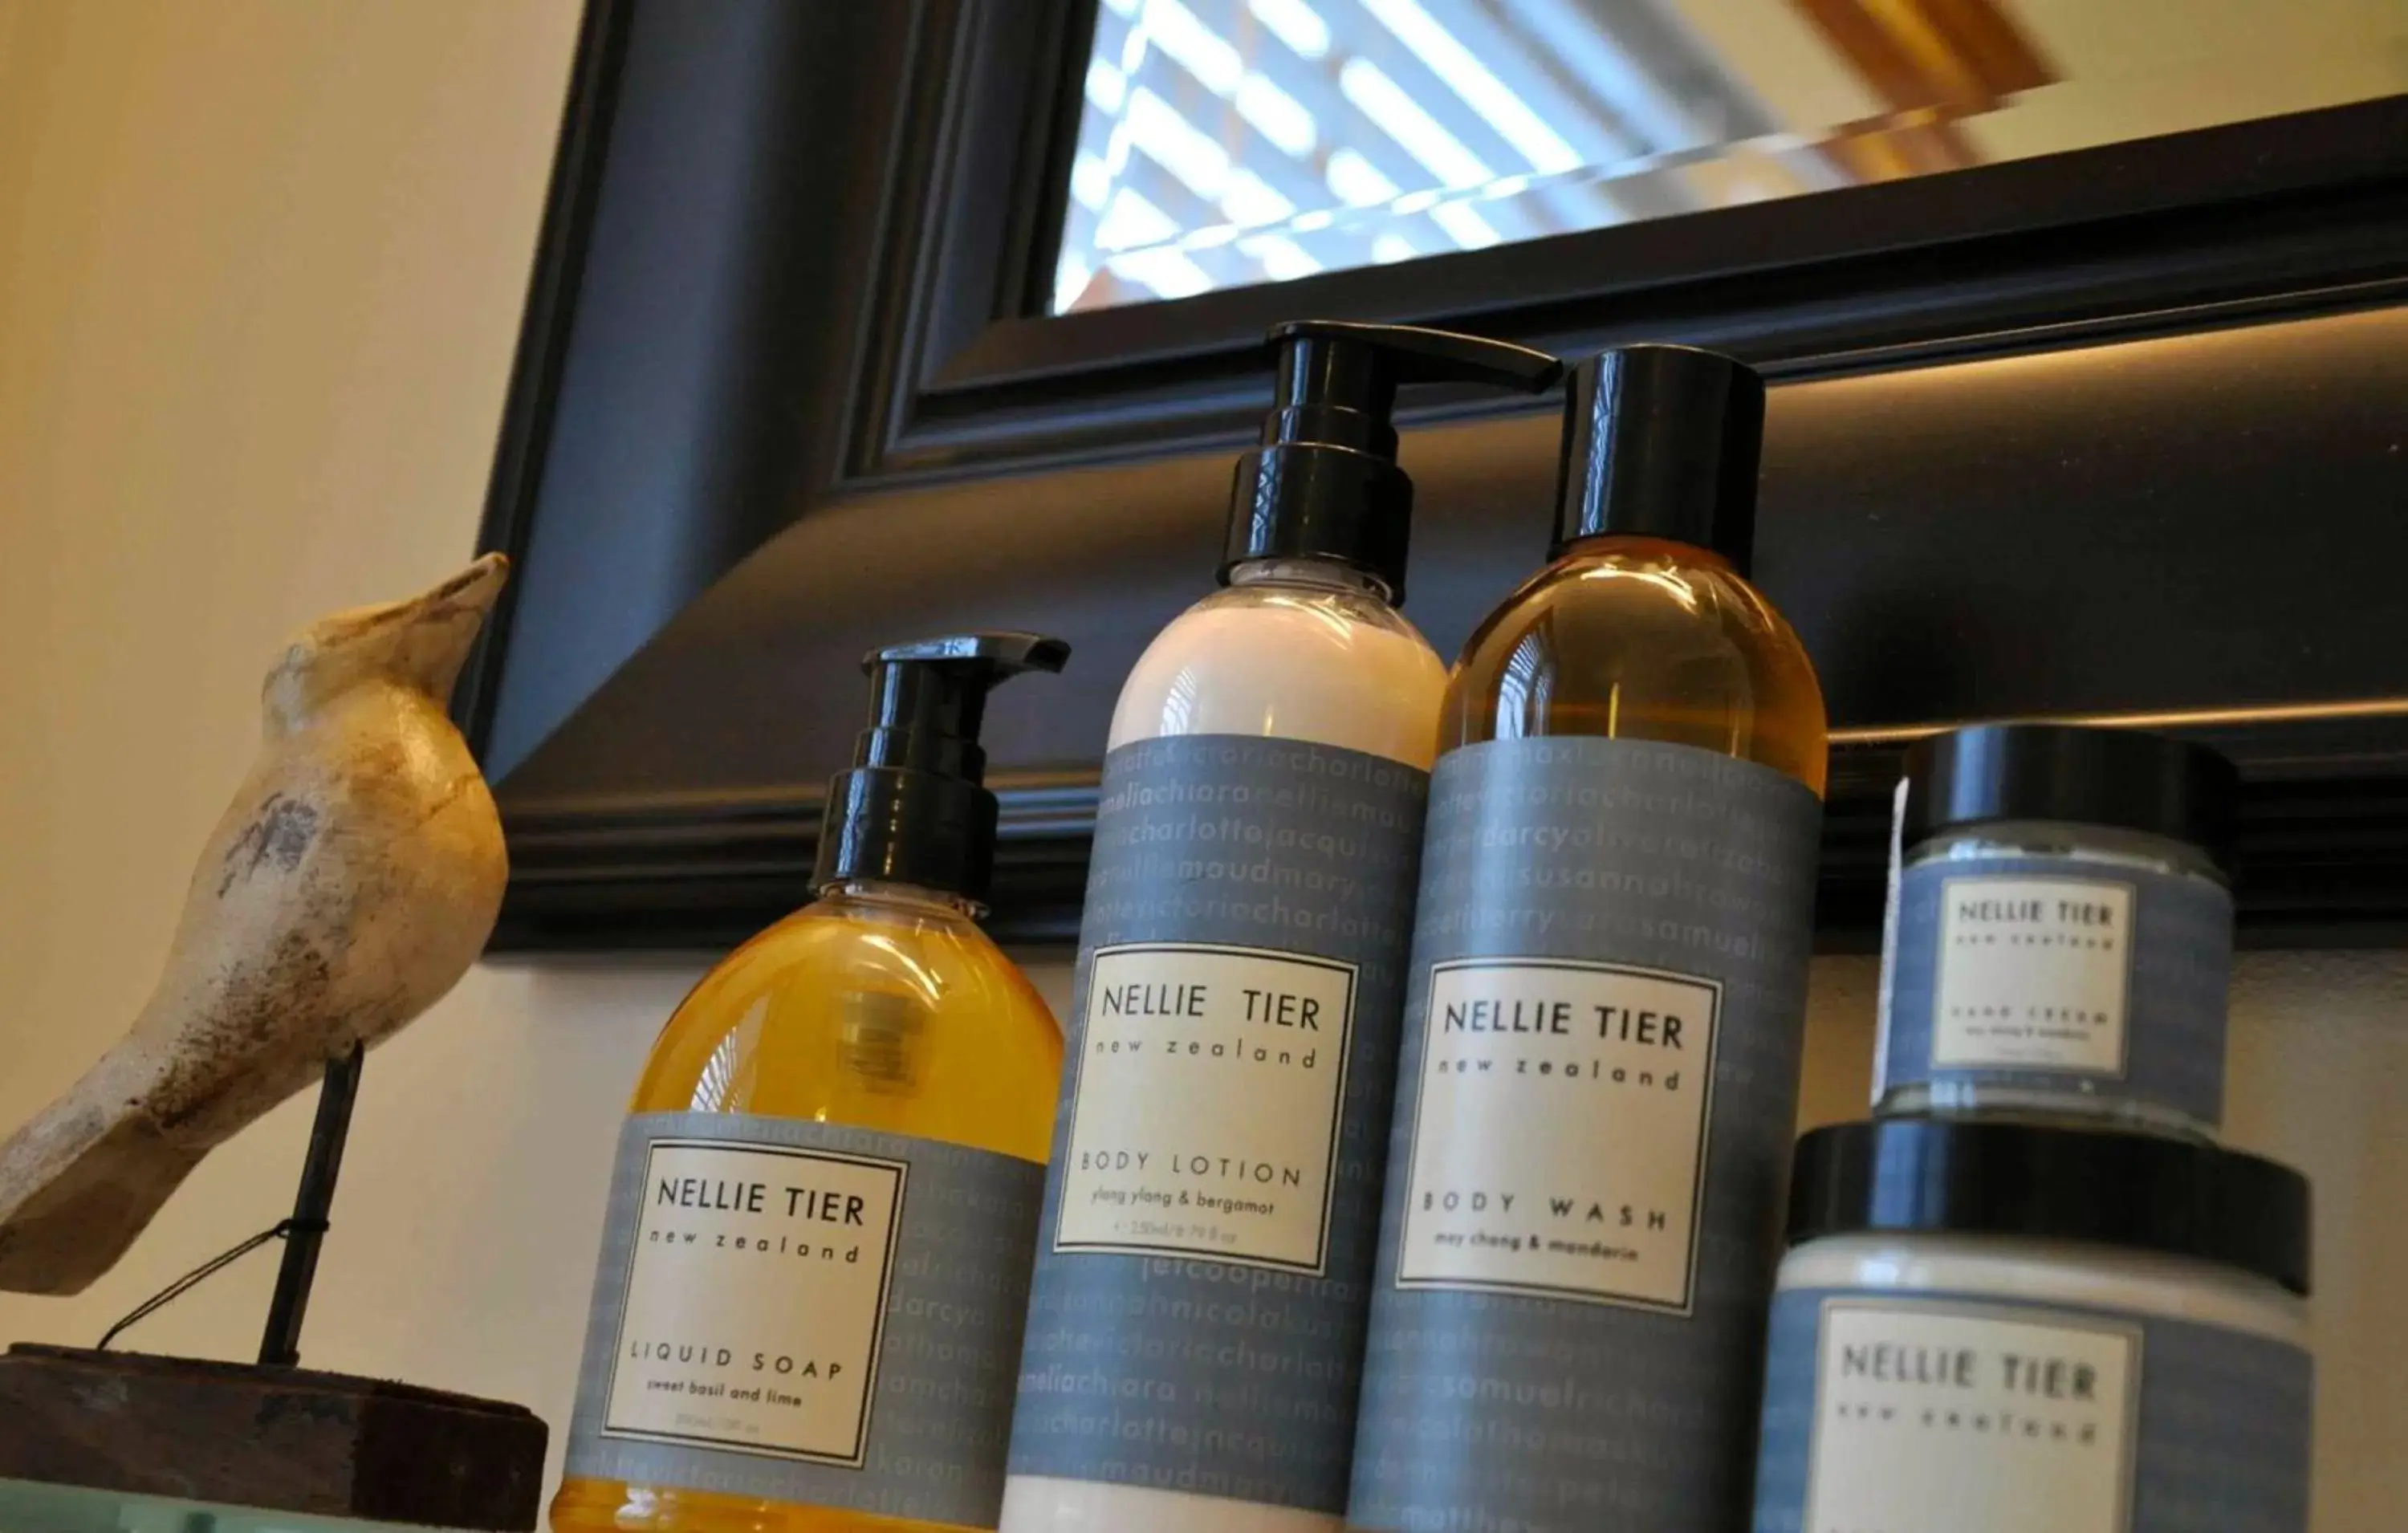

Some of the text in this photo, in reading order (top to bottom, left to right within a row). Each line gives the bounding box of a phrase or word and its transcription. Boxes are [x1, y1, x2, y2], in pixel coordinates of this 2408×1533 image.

[1959, 899, 2113, 928] NELLIE TIER
[1102, 985, 1320, 1032] NELLIE TIER
[1444, 1000, 1684, 1051] NELLIE TIER
[1096, 1039, 1316, 1070] new zealand
[1438, 1057, 1680, 1092] new zealand
[1081, 1149, 1301, 1188] BODY LOTION
[657, 1176, 766, 1214] NELLIE
[785, 1186, 865, 1227] TIER
[1130, 1186, 1172, 1208] ylang
[1178, 1189, 1190, 1206] &
[1197, 1189, 1275, 1215] bergamot
[1422, 1191, 1666, 1232] BODY WASH
[649, 1229, 860, 1264] new zealand
[630, 1340, 842, 1381] LIQUID SOAP
[1841, 1344, 2097, 1401] NELLIE TIER
[647, 1379, 802, 1408] sweet basil and lime
